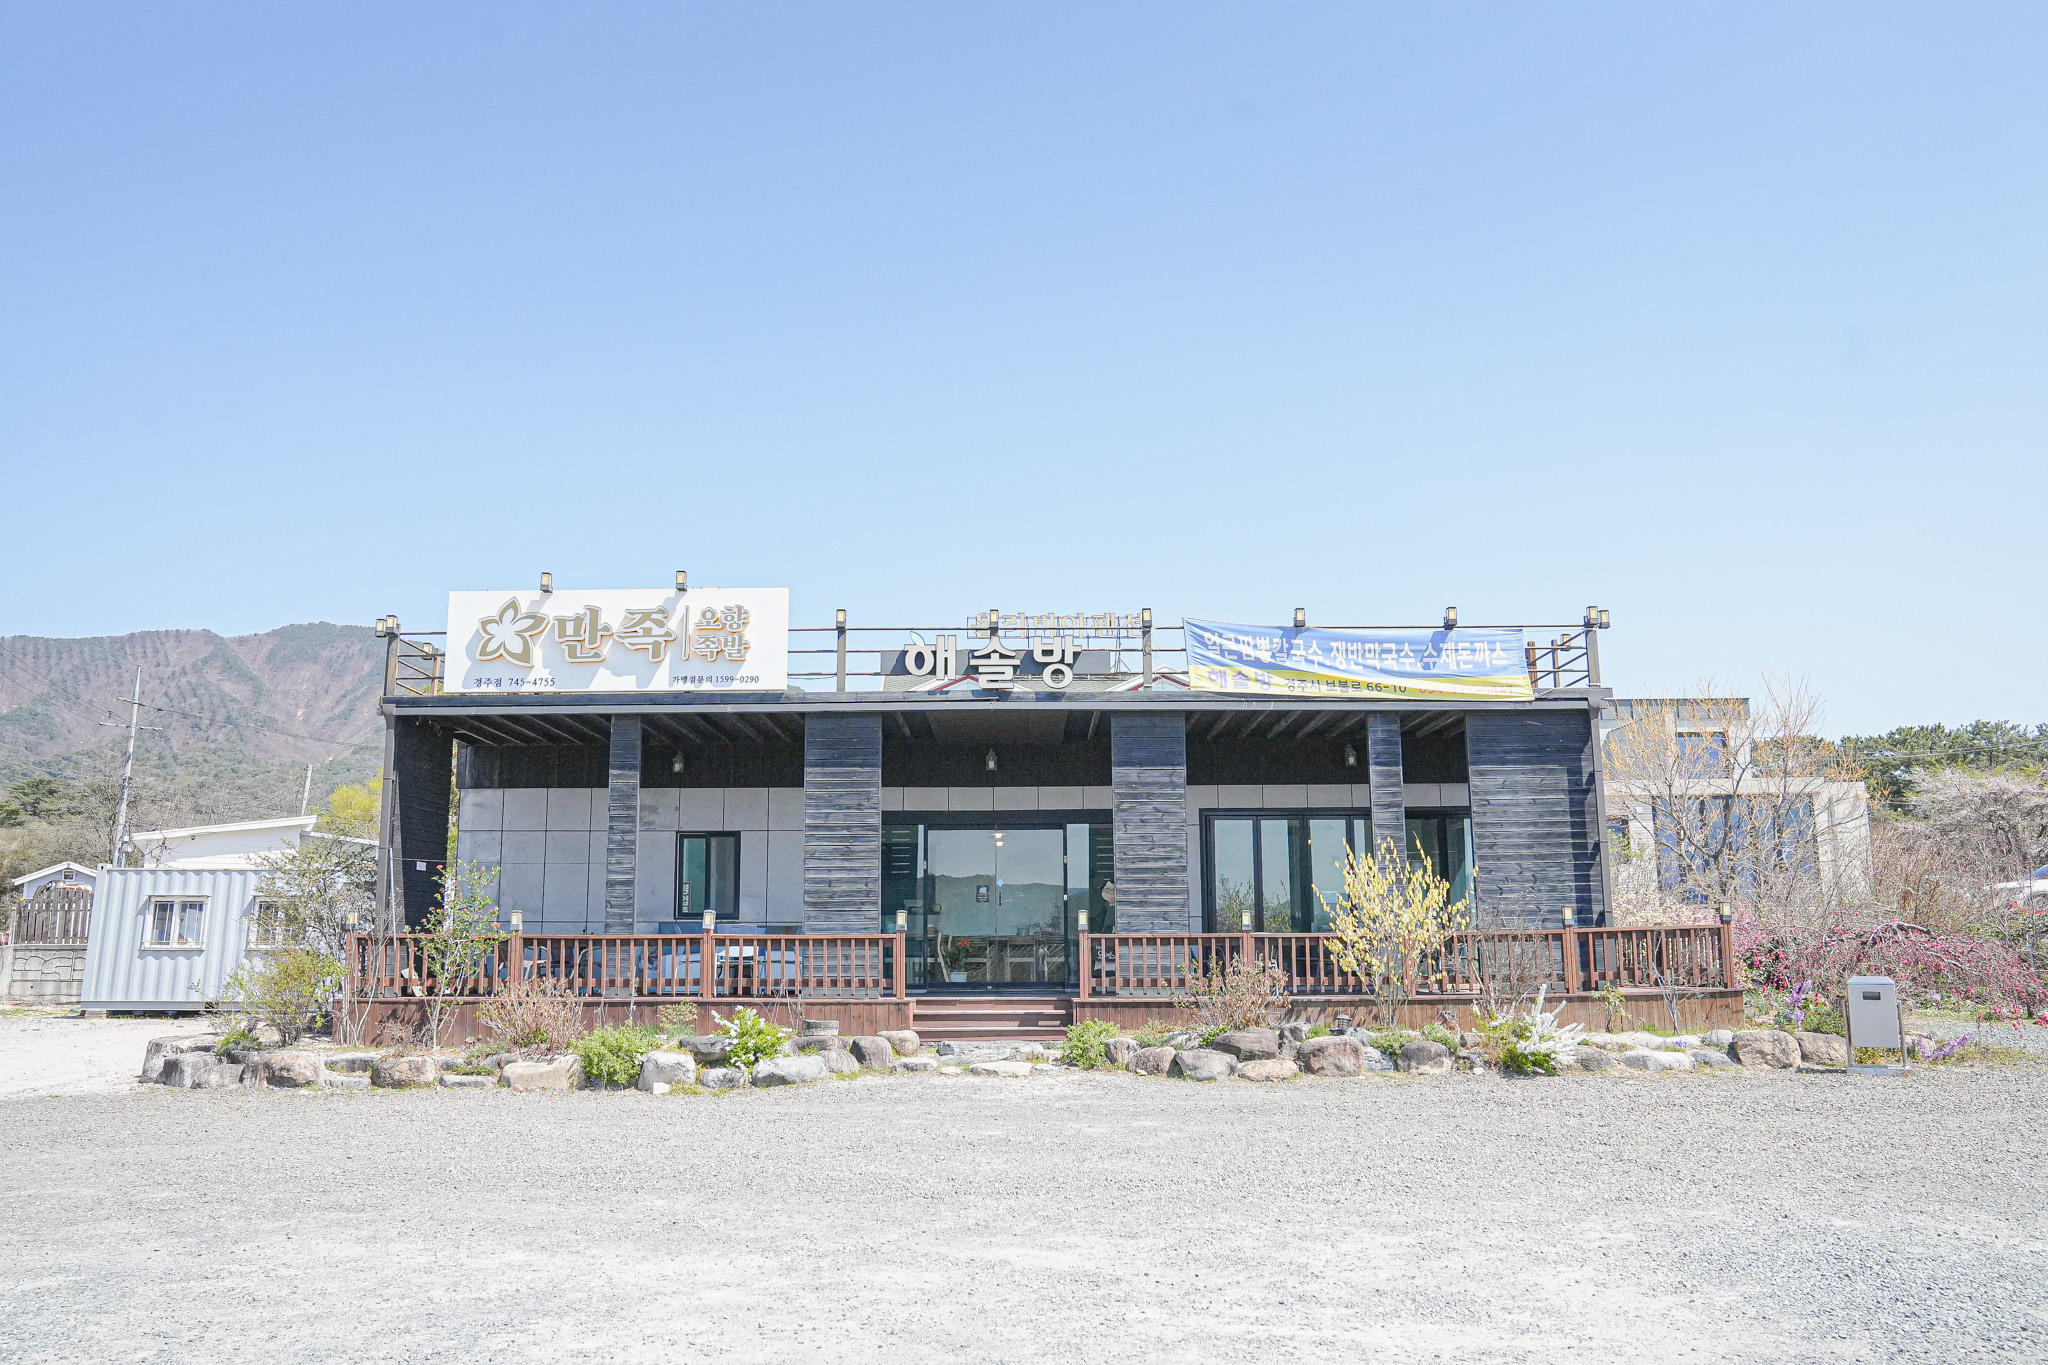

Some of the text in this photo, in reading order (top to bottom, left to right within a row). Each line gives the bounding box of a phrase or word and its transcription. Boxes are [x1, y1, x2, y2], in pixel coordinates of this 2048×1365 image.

[695, 604, 749, 632] 오향
[553, 605, 677, 663] 만족
[692, 633, 750, 662] 족발
[903, 635, 1082, 689] 해솔방
[474, 677, 555, 688] 경주점 745-4755
[715, 675, 760, 683] 1599-0290
[1284, 678, 1321, 692] 경주시
[1325, 680, 1363, 693] 보불로
